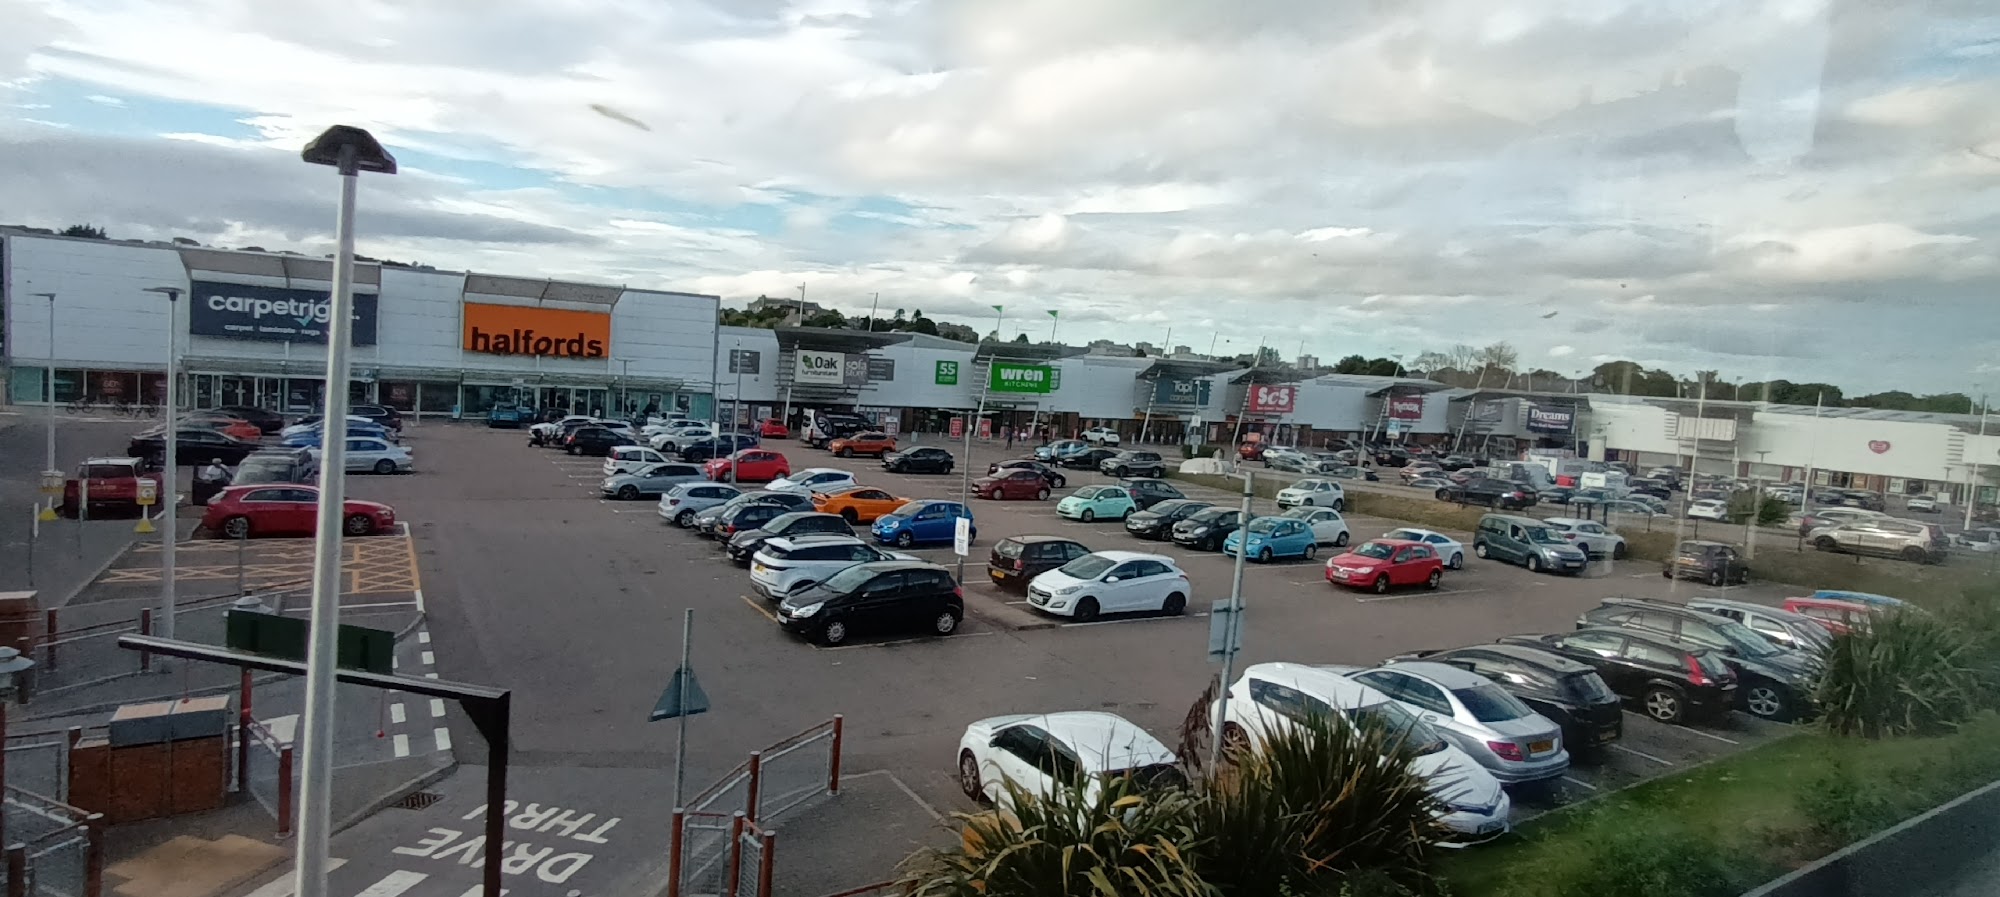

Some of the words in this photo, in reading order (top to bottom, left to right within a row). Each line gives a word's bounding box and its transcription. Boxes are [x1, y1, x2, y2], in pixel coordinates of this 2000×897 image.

[208, 295, 360, 323] carpetrig.
[471, 327, 603, 357] halfords
[815, 356, 839, 370] Oak
[845, 359, 867, 370] sofa
[940, 363, 956, 375] 55
[1000, 368, 1044, 382] wren
[1172, 380, 1193, 395] Tapi
[1257, 386, 1290, 406] ScS
[1531, 408, 1570, 421] Dreams
[391, 827, 593, 884] DRIVE
